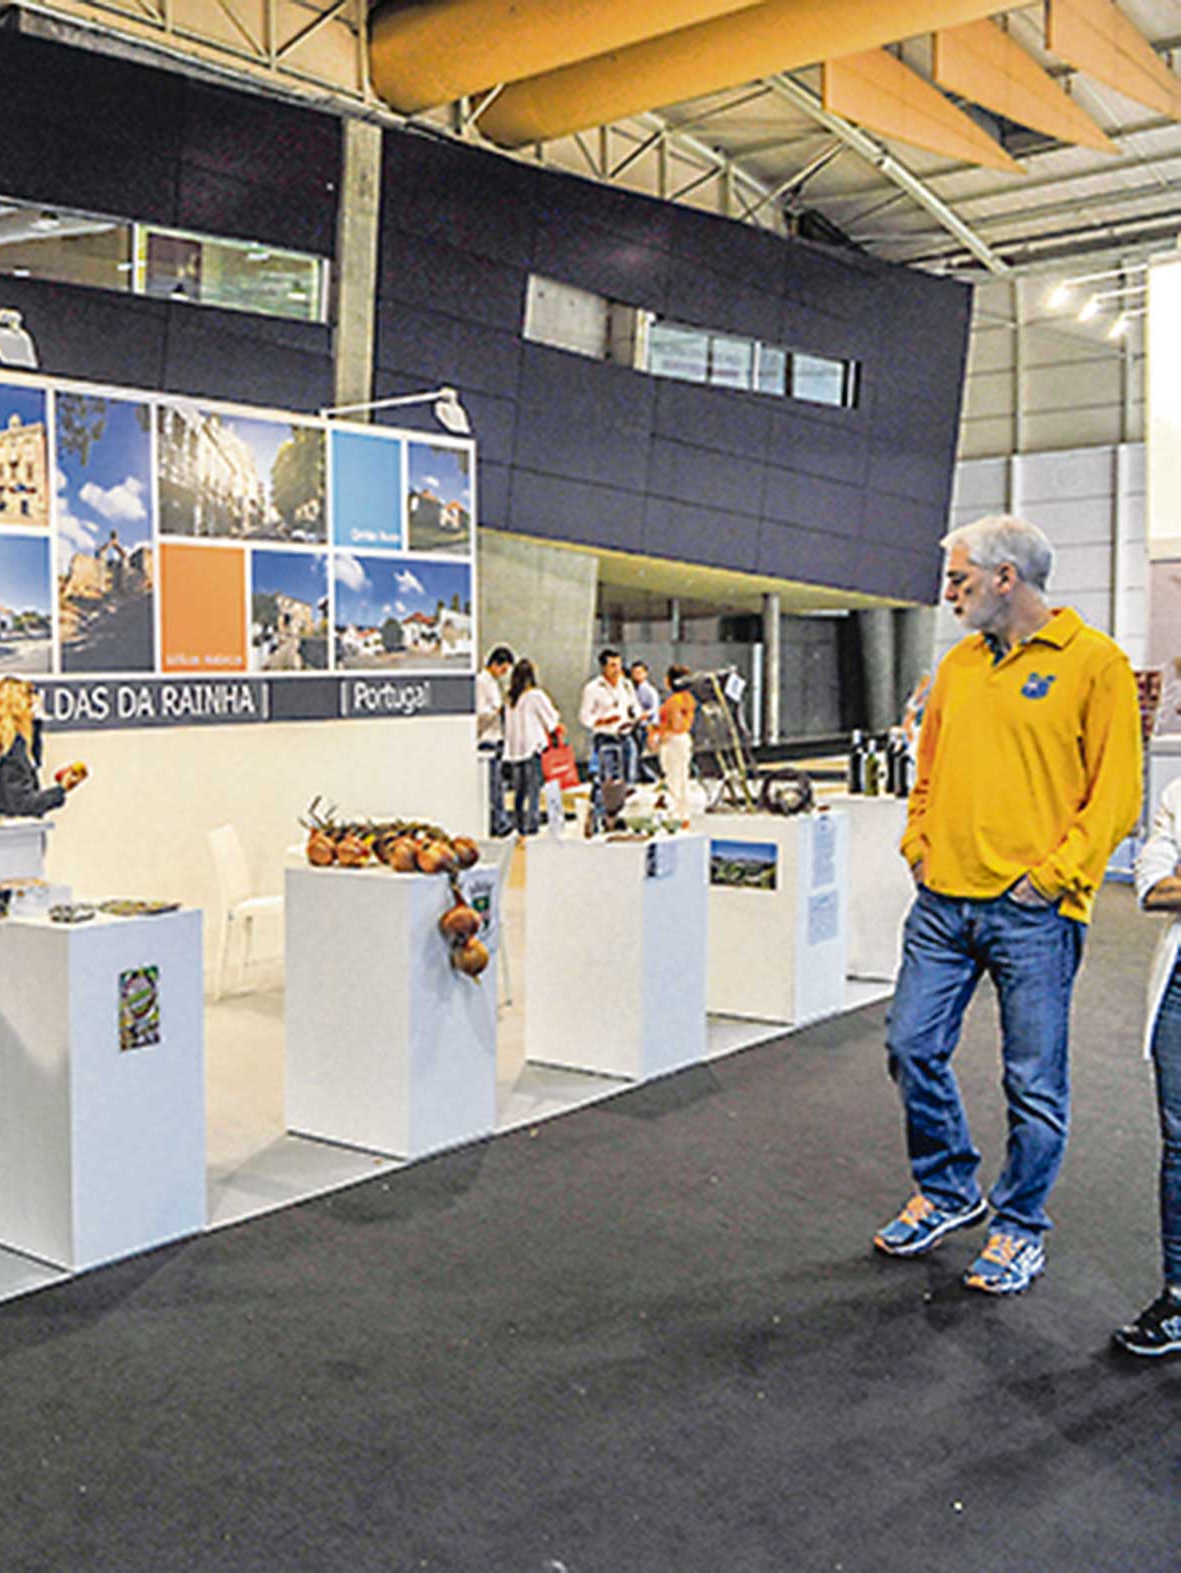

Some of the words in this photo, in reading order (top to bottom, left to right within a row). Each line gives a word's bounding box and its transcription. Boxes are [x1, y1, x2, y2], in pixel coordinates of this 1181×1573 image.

[117, 686, 156, 718] DA
[161, 682, 256, 717] RAINHA
[353, 681, 431, 715] Portugal
